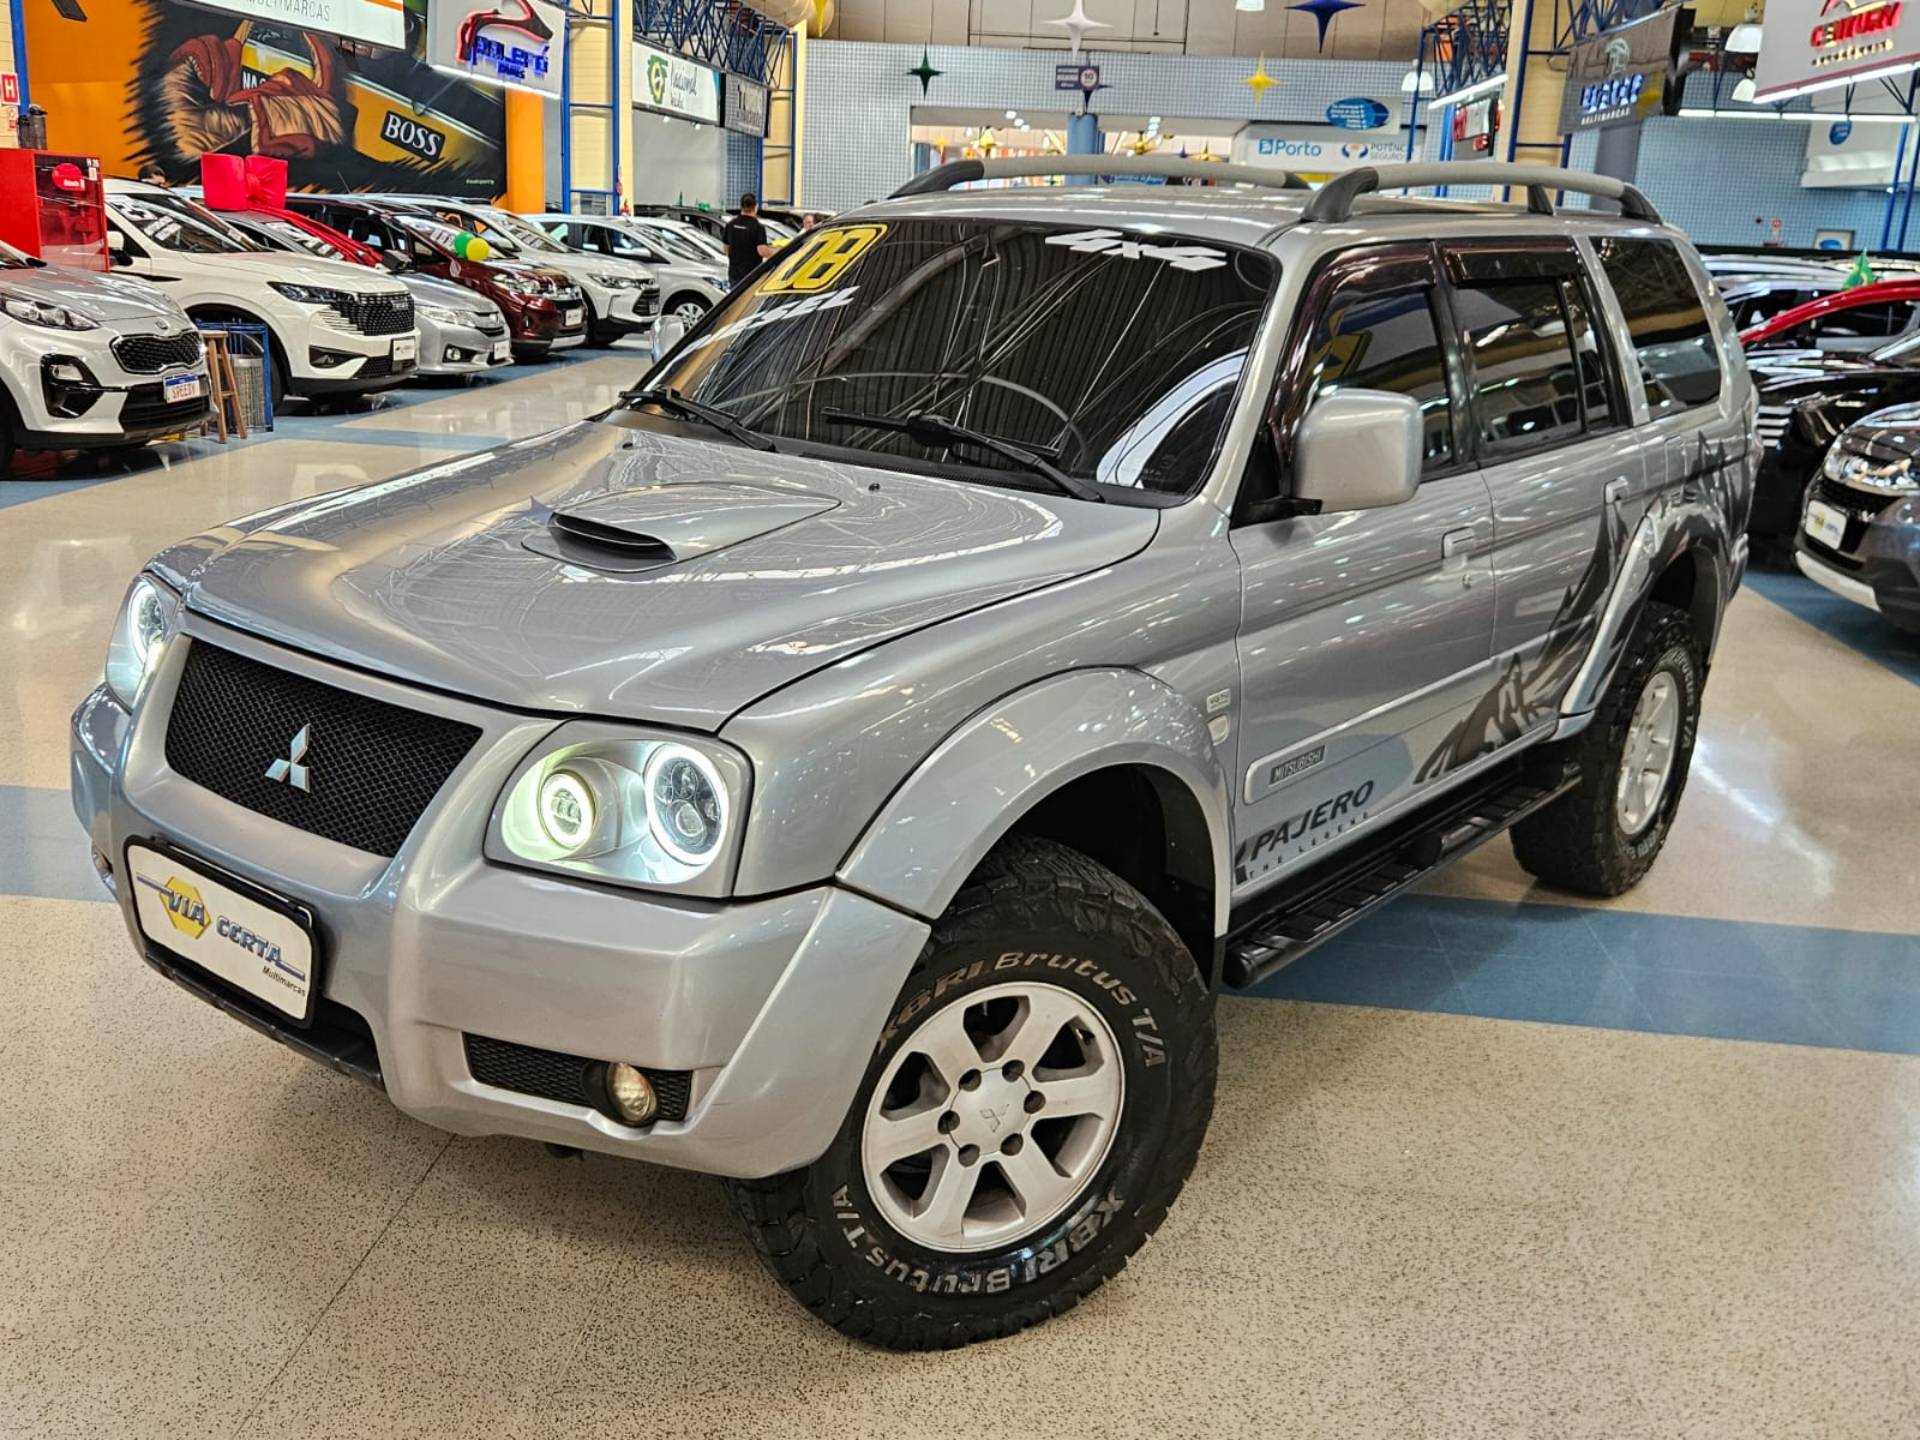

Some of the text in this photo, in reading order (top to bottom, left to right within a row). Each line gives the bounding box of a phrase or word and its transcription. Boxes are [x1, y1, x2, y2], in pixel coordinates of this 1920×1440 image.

[1811, 1, 1901, 47] CENTURY
[6, 79, 17, 99] H
[384, 113, 441, 156] BOSS
[1275, 140, 1322, 157] Porto
[1371, 142, 1406, 153] POTÊNC
[1371, 153, 1405, 161] SEGURO
[1251, 780, 1374, 861] PAJERO
[167, 890, 283, 964] VIA CERTA
[262, 965, 307, 998] Multimarcas
[1132, 1007, 1166, 1067] T/A
